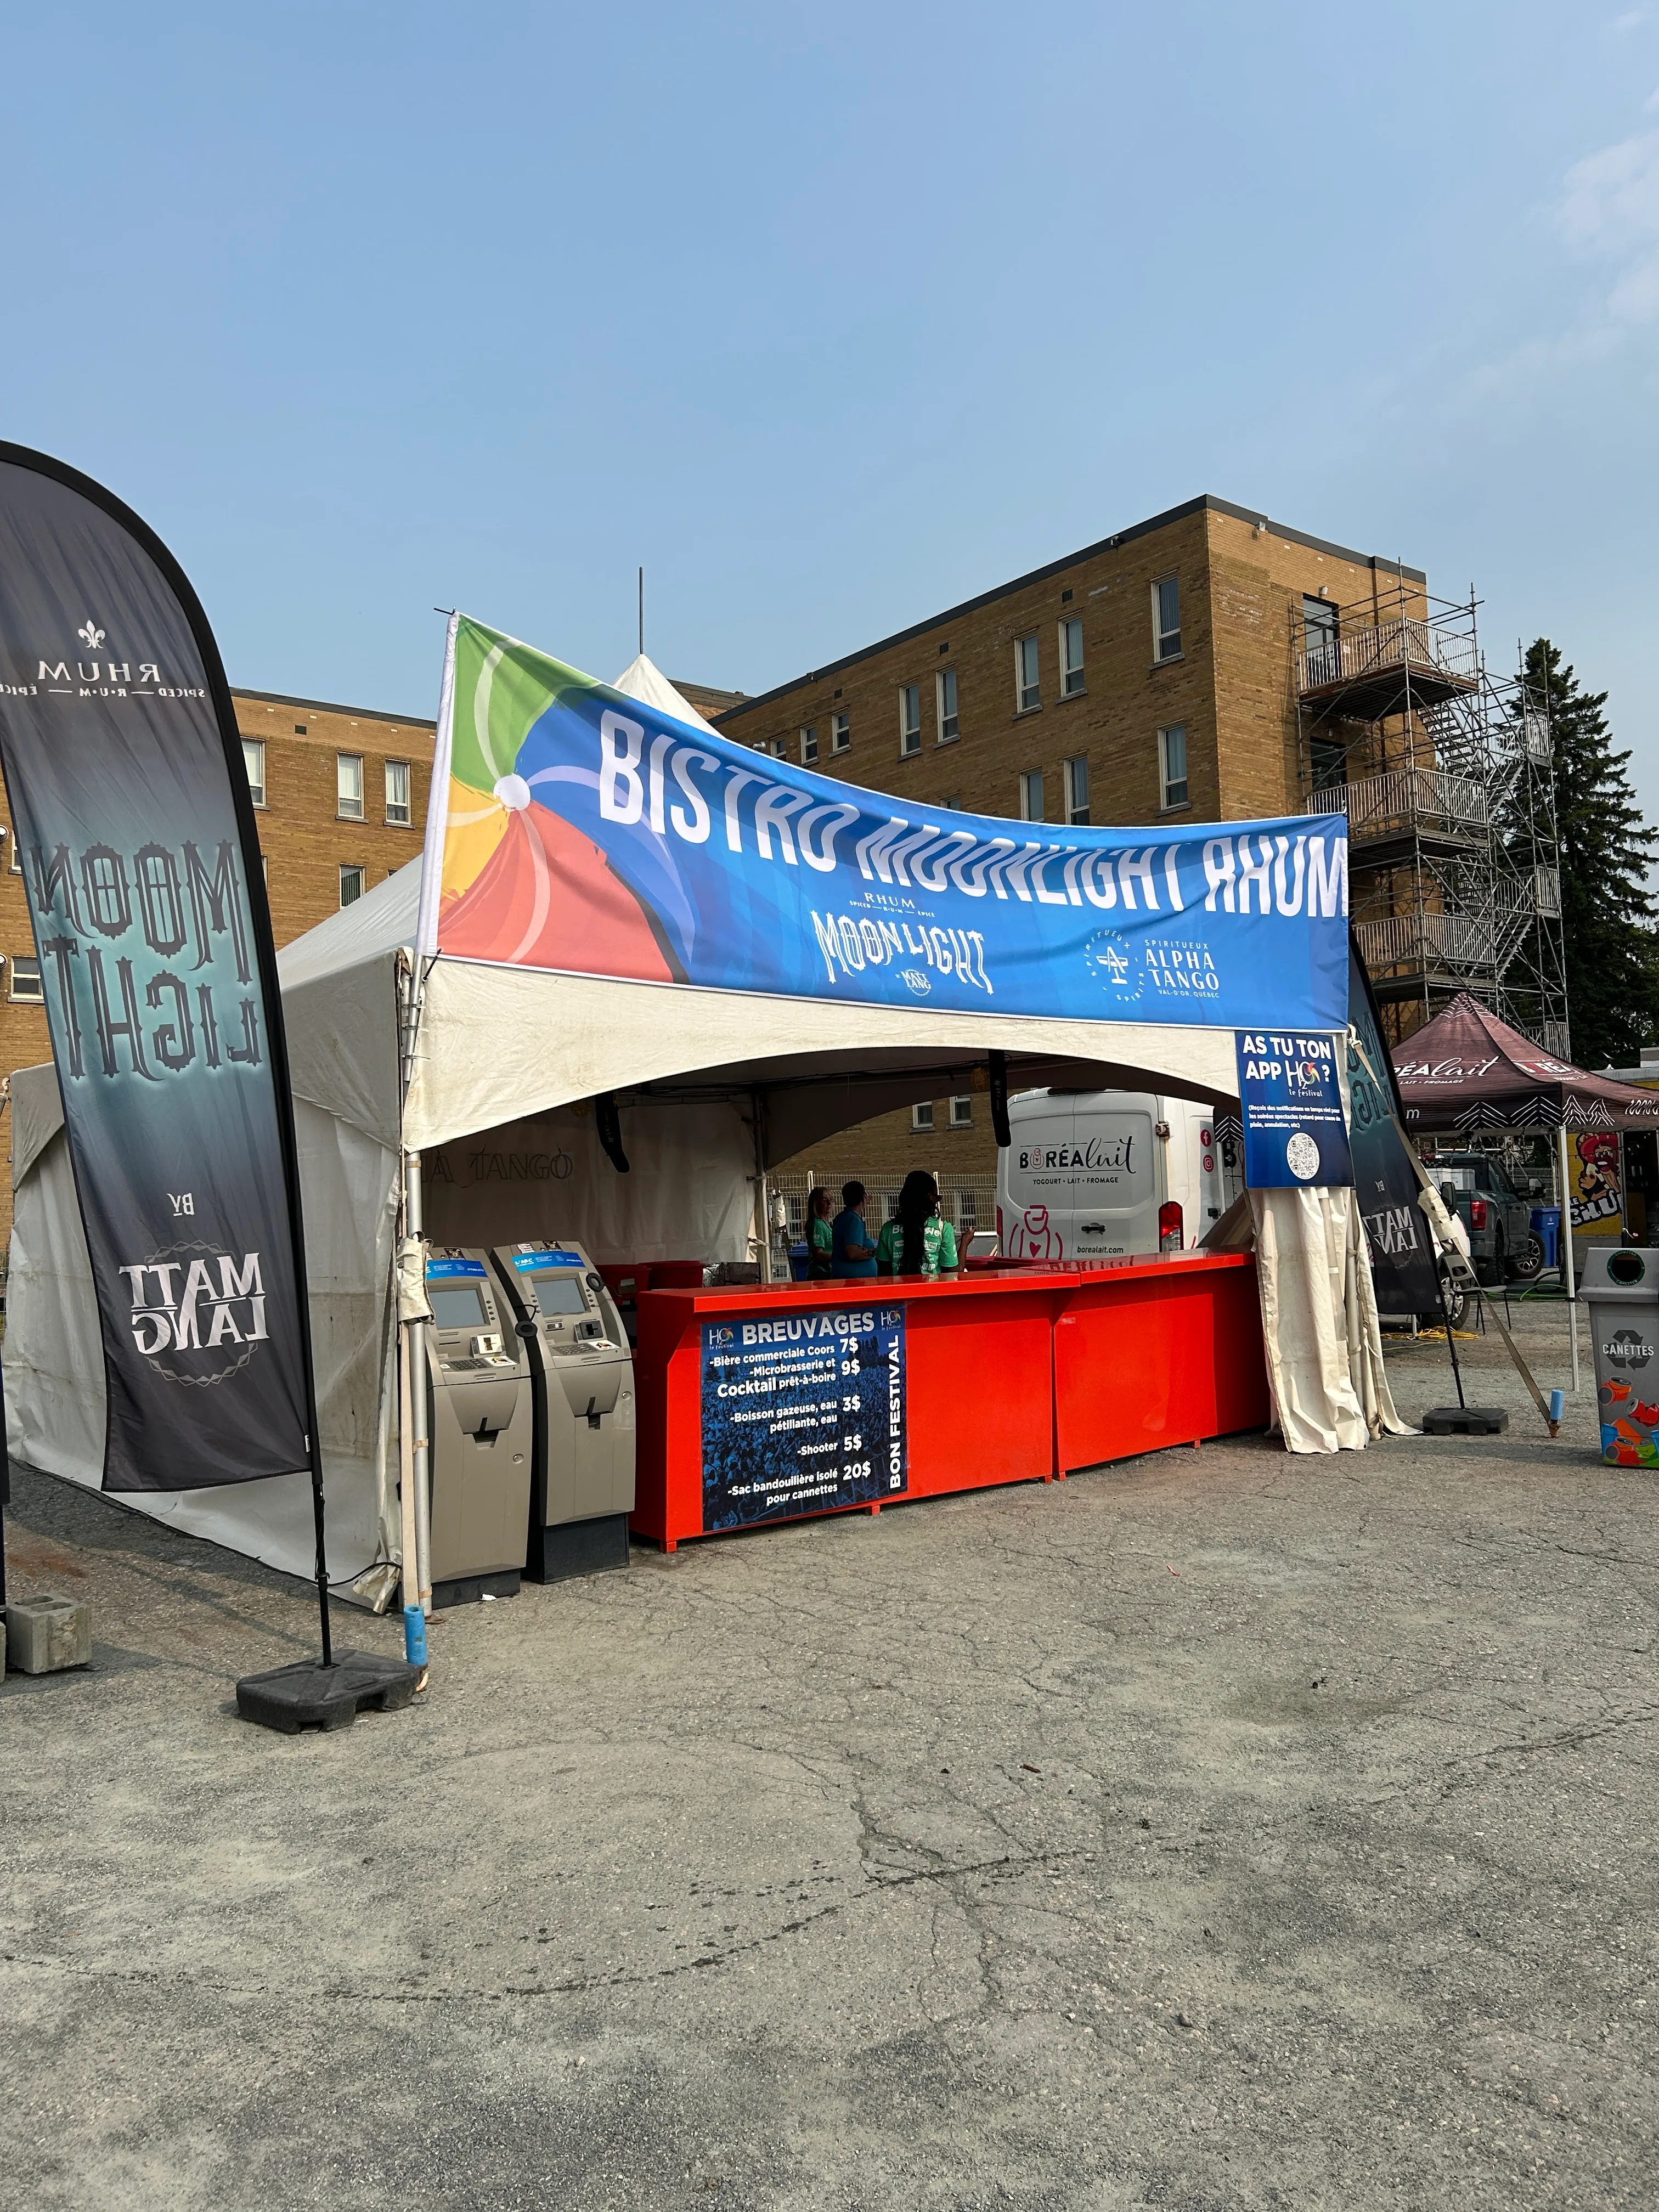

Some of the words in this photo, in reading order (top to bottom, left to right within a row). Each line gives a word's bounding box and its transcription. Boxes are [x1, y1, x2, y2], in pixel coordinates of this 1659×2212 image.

[599, 709, 861, 872] BISTRO
[855, 815, 1191, 912] MOONLIGHT
[1201, 835, 1348, 918] RHUM
[849, 900, 871, 909] SPICED
[864, 891, 916, 909] RHUM
[1144, 939, 1209, 950] SPIRITUEUX
[1146, 949, 1215, 970] ALPHA
[900, 970, 927, 981] MATT
[906, 979, 932, 989] LANG
[1148, 969, 1220, 990] TANGO
[1243, 1035, 1267, 1054] AS
[1269, 1037, 1294, 1057] TU
[1295, 1039, 1331, 1059] TON
[1245, 1060, 1282, 1080] APP
[1321, 1064, 1330, 1082] ?
[470, 1153, 573, 1180] TANGO
[1077, 1245, 1124, 1254] borealait.com
[742, 1312, 874, 1345] BREUVAGES
[709, 1355, 741, 1367] -Bière
[743, 1347, 805, 1363] commerciale
[807, 1345, 835, 1356] Coors
[839, 1336, 859, 1353] 7$
[1602, 1344, 1655, 1356] CANETTES
[749, 1359, 824, 1376] -Microbrasserie
[826, 1358, 836, 1368] et
[841, 1358, 860, 1376] 9$
[717, 1376, 776, 1398] Cocktail
[779, 1372, 836, 1390] prêt-à-boire
[888, 1335, 901, 1437] FESTIVAL
[730, 1410, 774, 1423] -Boisson
[776, 1404, 819, 1419] gazeuse,
[820, 1401, 837, 1410] eau
[843, 1394, 861, 1412] 3$
[770, 1417, 819, 1434] pétillante,
[821, 1414, 837, 1424] eau
[797, 1442, 838, 1455] -Shooter
[844, 1434, 862, 1451] 5$
[890, 1442, 901, 1489] BON
[727, 1485, 751, 1496] -Sac
[816, 1468, 838, 1481] isolé
[843, 1460, 871, 1481] 20$
[766, 1492, 790, 1506] pour
[792, 1484, 838, 1499] cannettes
